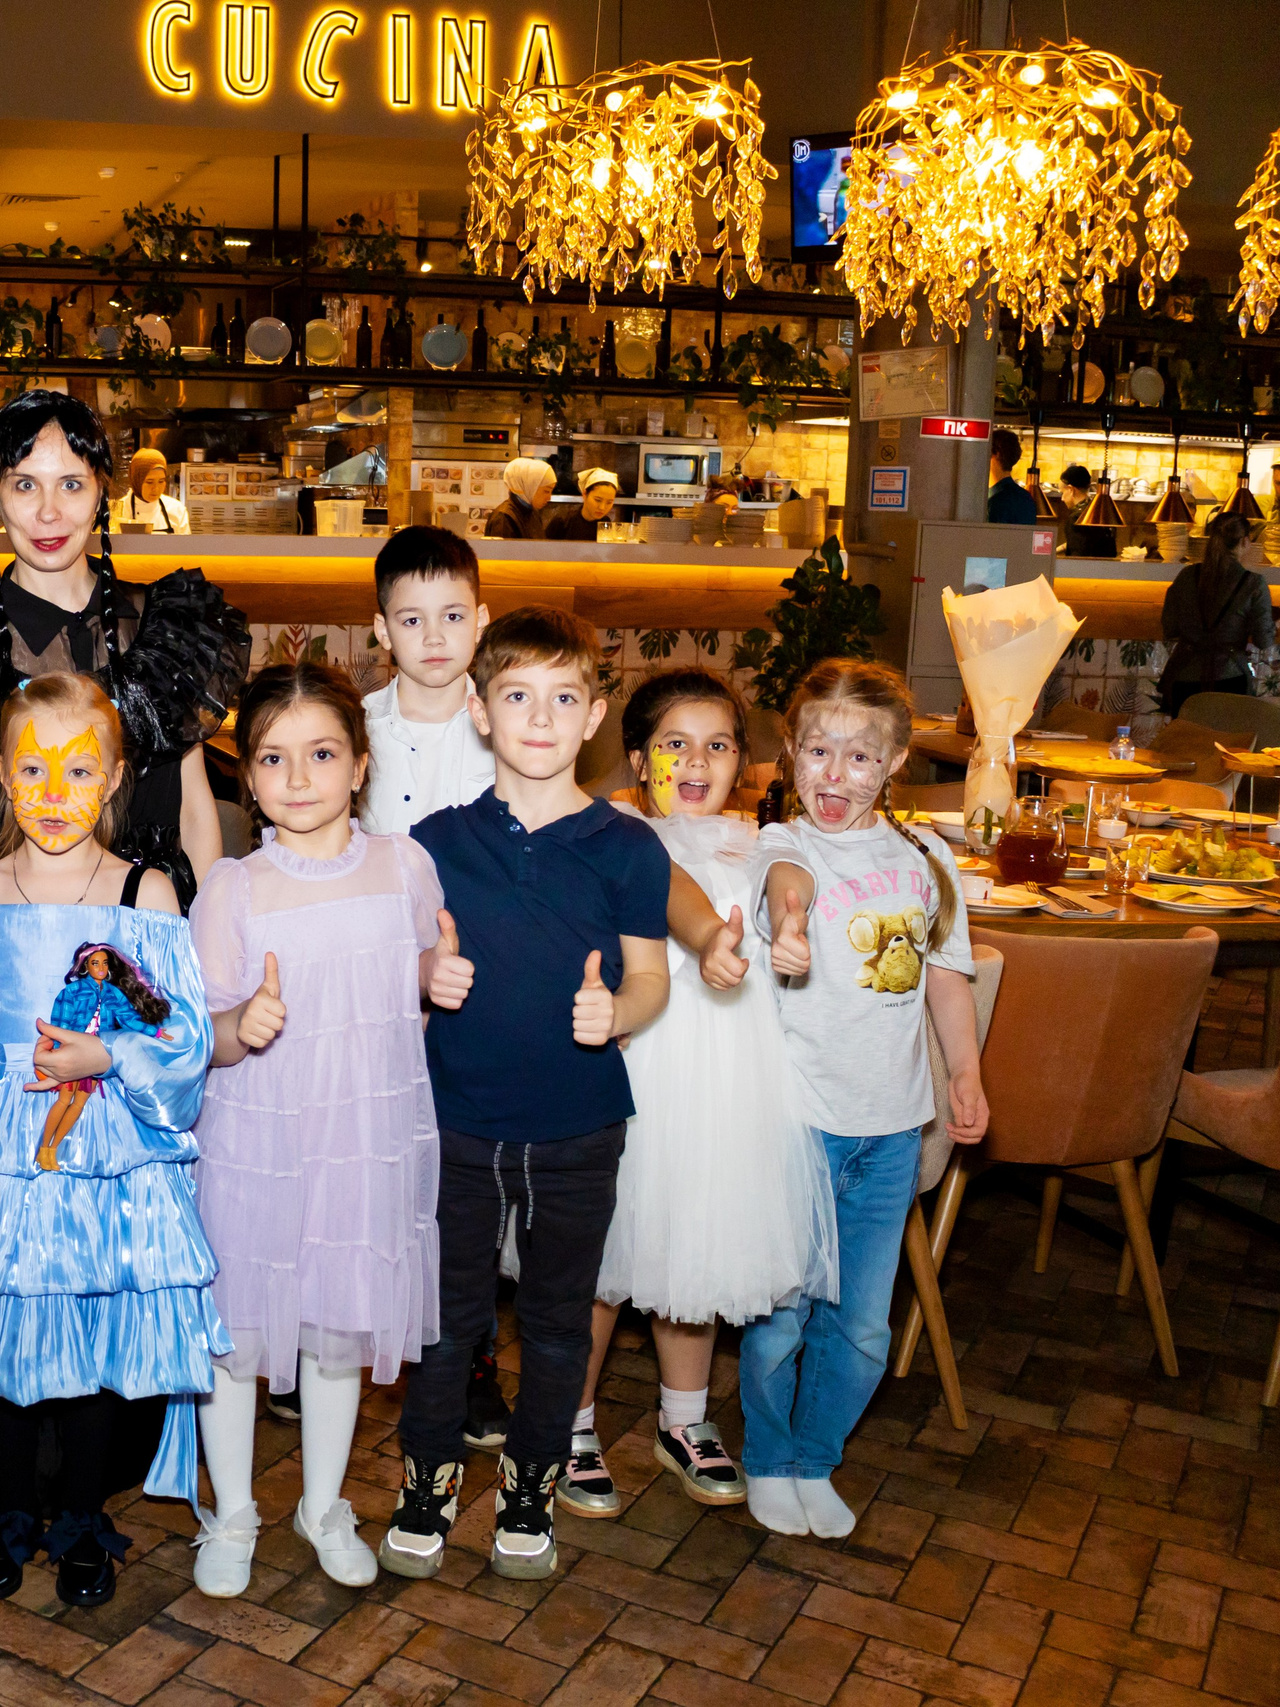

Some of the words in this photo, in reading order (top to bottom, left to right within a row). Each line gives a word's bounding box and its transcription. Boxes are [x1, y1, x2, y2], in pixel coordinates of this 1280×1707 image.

[149, 0, 563, 112] CUCINA
[943, 420, 969, 436] ПК
[814, 869, 900, 922] EVERY
